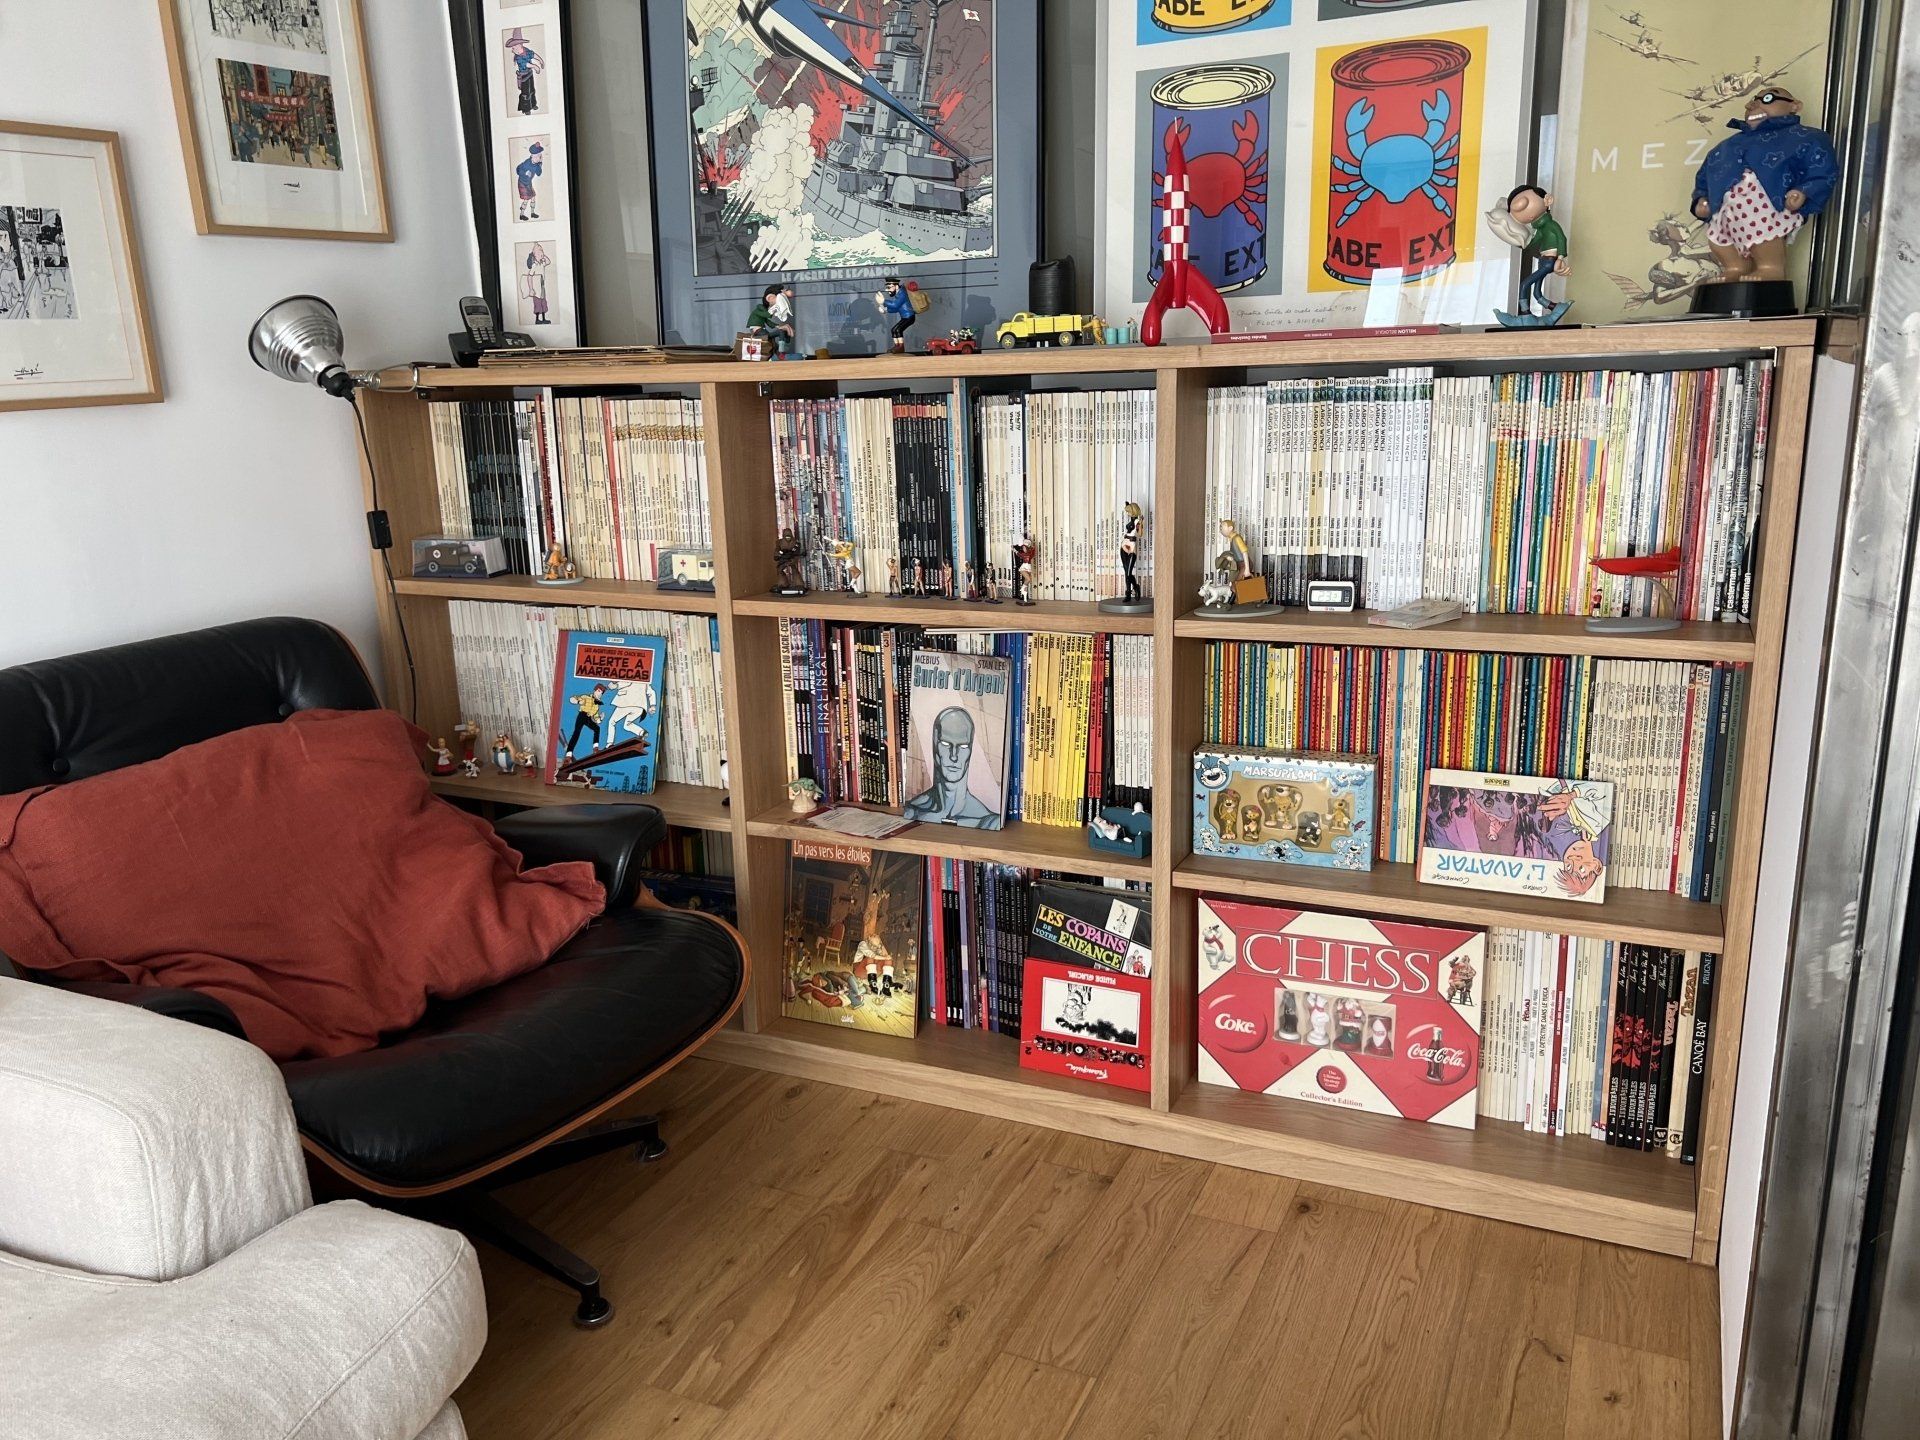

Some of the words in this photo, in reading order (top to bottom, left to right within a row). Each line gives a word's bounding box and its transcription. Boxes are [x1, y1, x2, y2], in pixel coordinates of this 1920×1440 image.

[1156, 0, 1204, 16] ABE
[1328, 234, 1382, 268] ABE
[781, 272, 792, 282] LE
[793, 270, 828, 282] SECRET
[831, 269, 843, 279] DE
[1727, 568, 1737, 609] casterman
[1742, 572, 1751, 614] casterman
[883, 639, 890, 648] 3
[584, 655, 628, 668] ALERTE
[635, 658, 644, 669] A
[782, 655, 791, 664] DU
[914, 654, 940, 666] MŒBIUS
[977, 660, 993, 669] STAN
[995, 661, 1006, 670] LEE
[576, 665, 649, 680] MARRACCAS
[782, 665, 792, 682] FOLLE
[815, 653, 823, 691] INCAL
[820, 652, 828, 691] INCAL
[913, 664, 951, 689] Surfer
[952, 668, 1006, 697] d'Argent
[783, 683, 793, 691] LA
[793, 840, 804, 855] Un
[805, 844, 818, 861] pas
[819, 846, 834, 859] vers
[835, 844, 846, 860] les
[846, 846, 871, 863] étoiles
[1437, 854, 1545, 881] L'AVATAR
[1522, 884, 1548, 894] CONRAD
[1035, 927, 1058, 941] VOTRE
[1038, 906, 1065, 927] LES
[1065, 919, 1127, 954] COPAINS
[1042, 923, 1053, 931] DE
[1059, 930, 1122, 968] ENFANCE
[1242, 932, 1430, 994] CHESS
[1702, 958, 1711, 985] PRUGNE
[1067, 970, 1095, 982] GLACIAL
[1095, 974, 1116, 985] FLUIDE
[1681, 967, 1698, 1017] Tarzan
[1214, 1013, 1255, 1034] Coke
[1695, 1019, 1707, 1038] BAY
[1025, 1046, 1032, 1055] 2
[1407, 1043, 1465, 1067] Coca-Cola
[1691, 1037, 1705, 1074] CANOË
[1065, 1063, 1109, 1080] Franquin
[1300, 1091, 1336, 1103] Collector's
[1338, 1097, 1363, 1107] Edition
